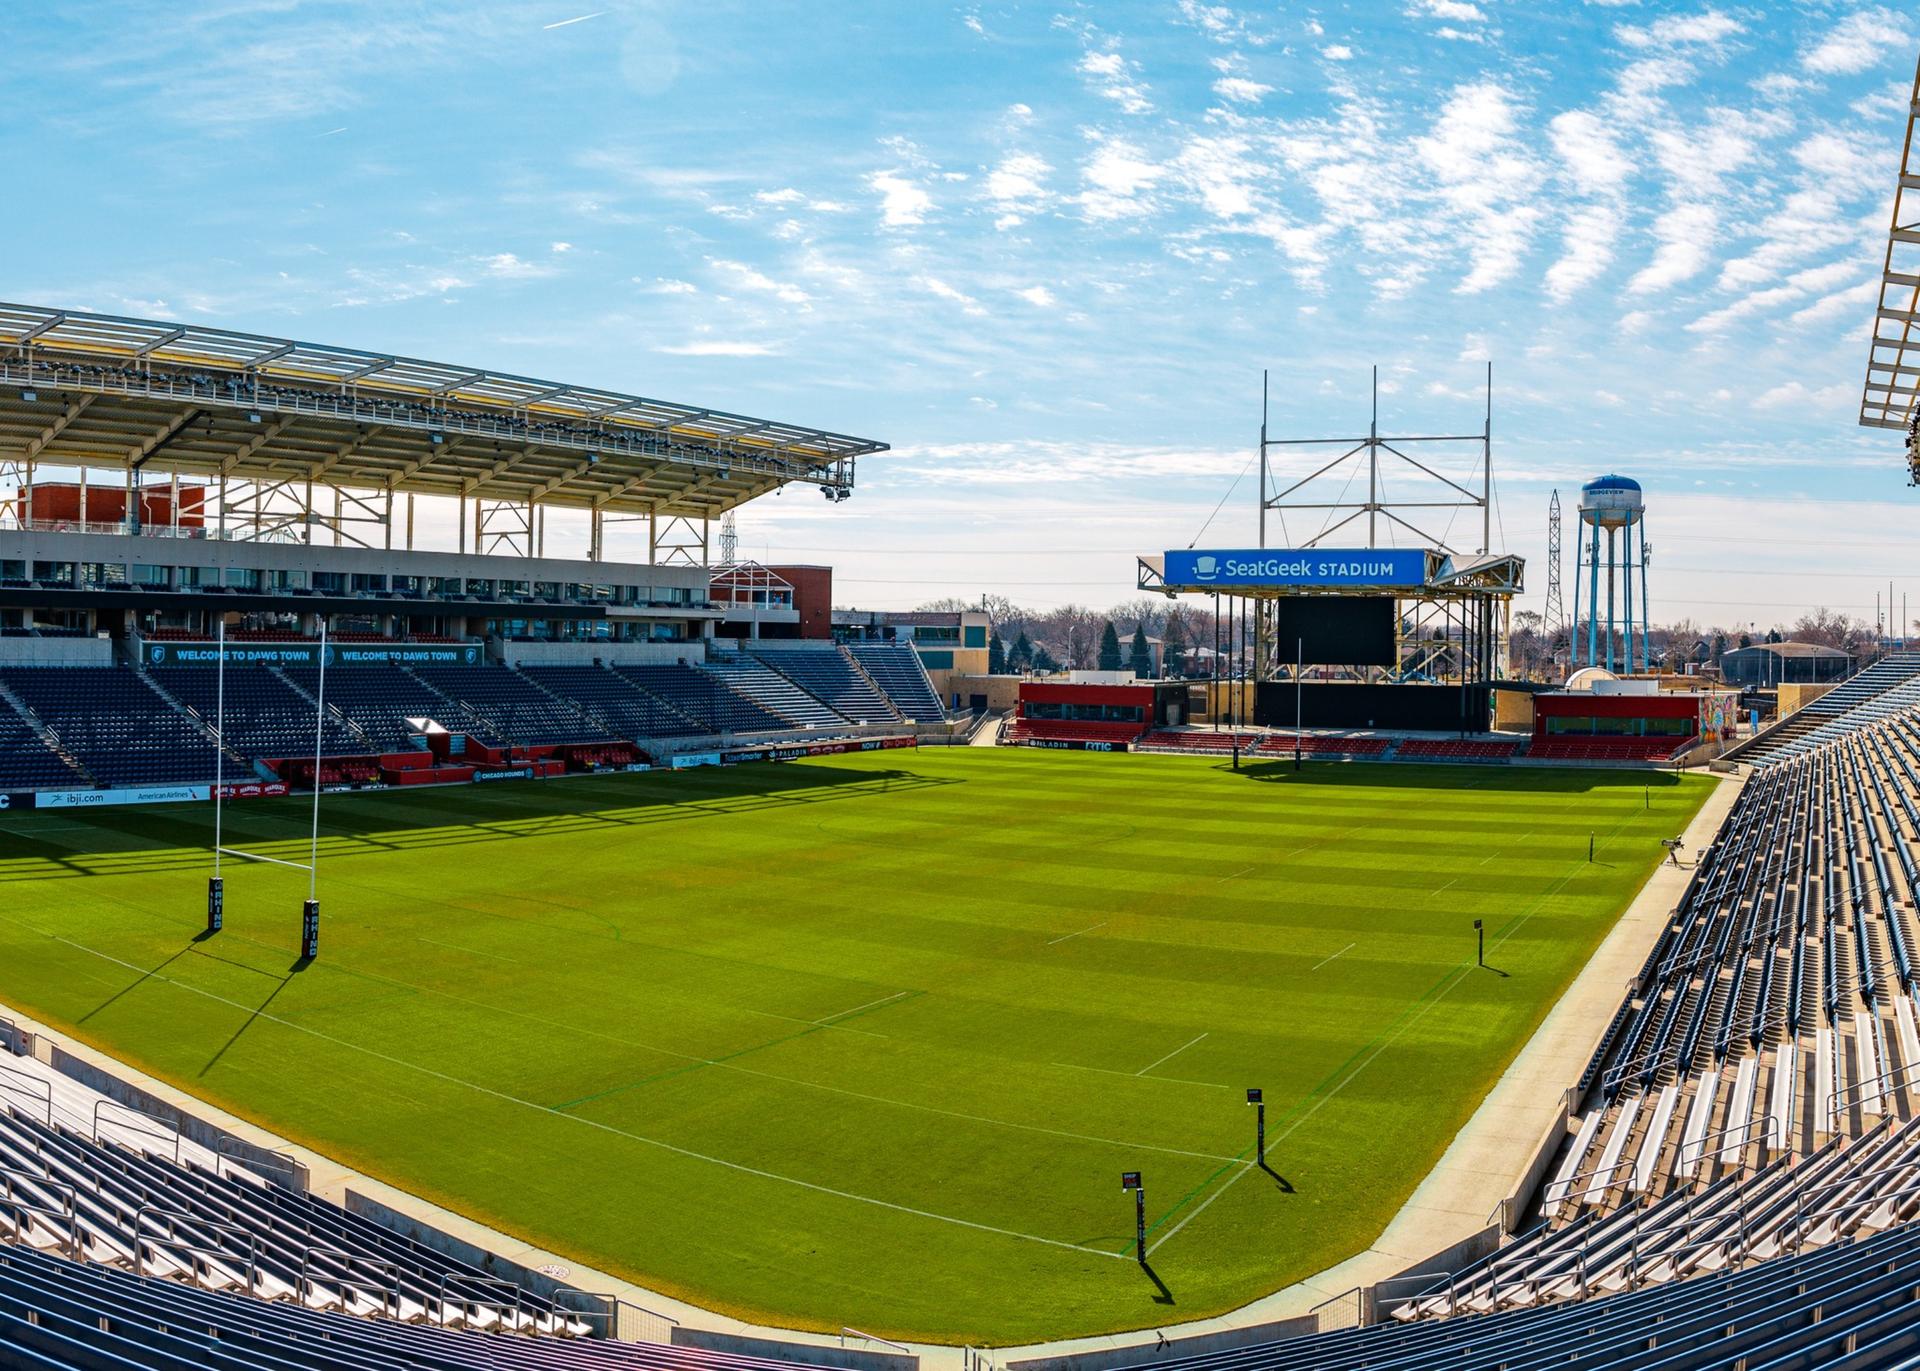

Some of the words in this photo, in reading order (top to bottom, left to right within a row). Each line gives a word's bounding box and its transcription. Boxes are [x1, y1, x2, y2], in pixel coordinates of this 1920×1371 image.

[1226, 559, 1312, 577] SeatGeek
[1318, 562, 1393, 576] STADIUM
[176, 650, 230, 661] WELCOME
[231, 651, 246, 661] TO
[247, 651, 278, 661] DAWG
[280, 651, 310, 661] TOWN
[342, 651, 388, 661] WELCOME
[389, 652, 402, 661] TO
[403, 652, 429, 661] DAWG
[431, 651, 457, 661] TOWN
[67, 794, 104, 805] ibji.com
[166, 791, 188, 799] Airlines
